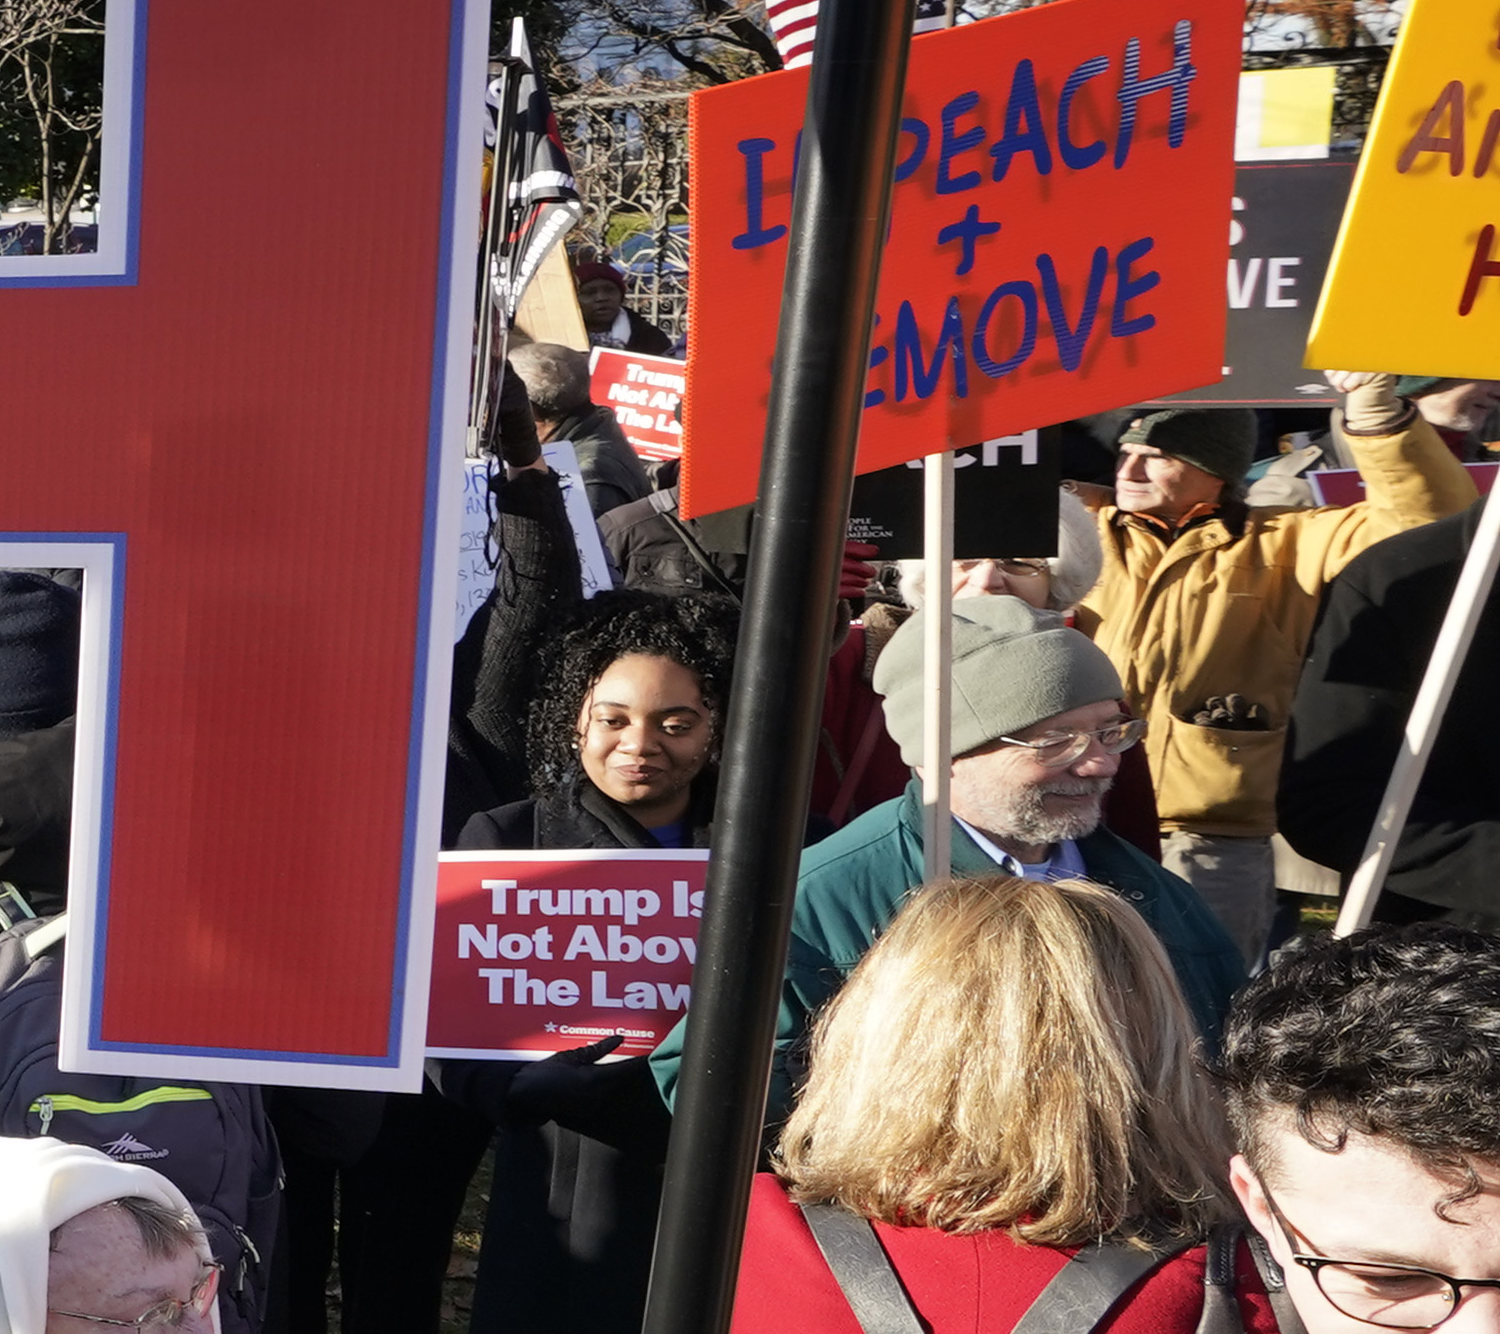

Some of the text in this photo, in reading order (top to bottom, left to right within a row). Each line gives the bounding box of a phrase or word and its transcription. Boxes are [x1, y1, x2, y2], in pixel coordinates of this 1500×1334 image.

[608, 383, 649, 405] Not
[615, 406, 654, 429] The
[481, 880, 661, 925] Trump
[458, 923, 697, 965] Not Abov
[478, 968, 691, 1011] The Law
[559, 1024, 615, 1036] Common
